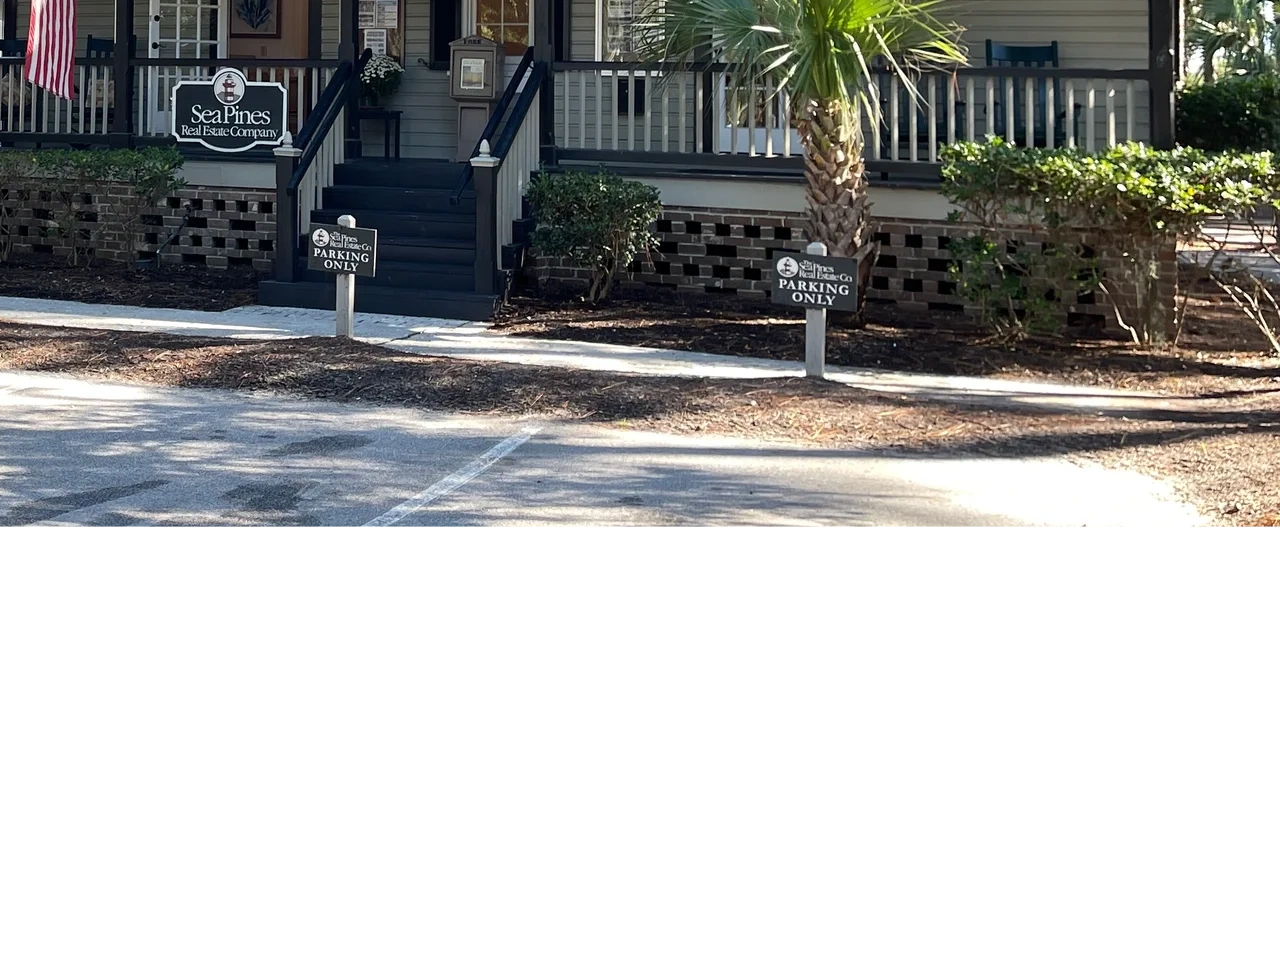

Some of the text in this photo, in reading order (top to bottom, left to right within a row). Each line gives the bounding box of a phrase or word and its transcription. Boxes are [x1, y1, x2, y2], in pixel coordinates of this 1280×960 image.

[181, 124, 279, 140] Real Estate Company
[313, 248, 369, 263] PARKING
[323, 259, 359, 272] ONLY
[778, 278, 850, 296] PARKING
[791, 291, 836, 306] ONLY
